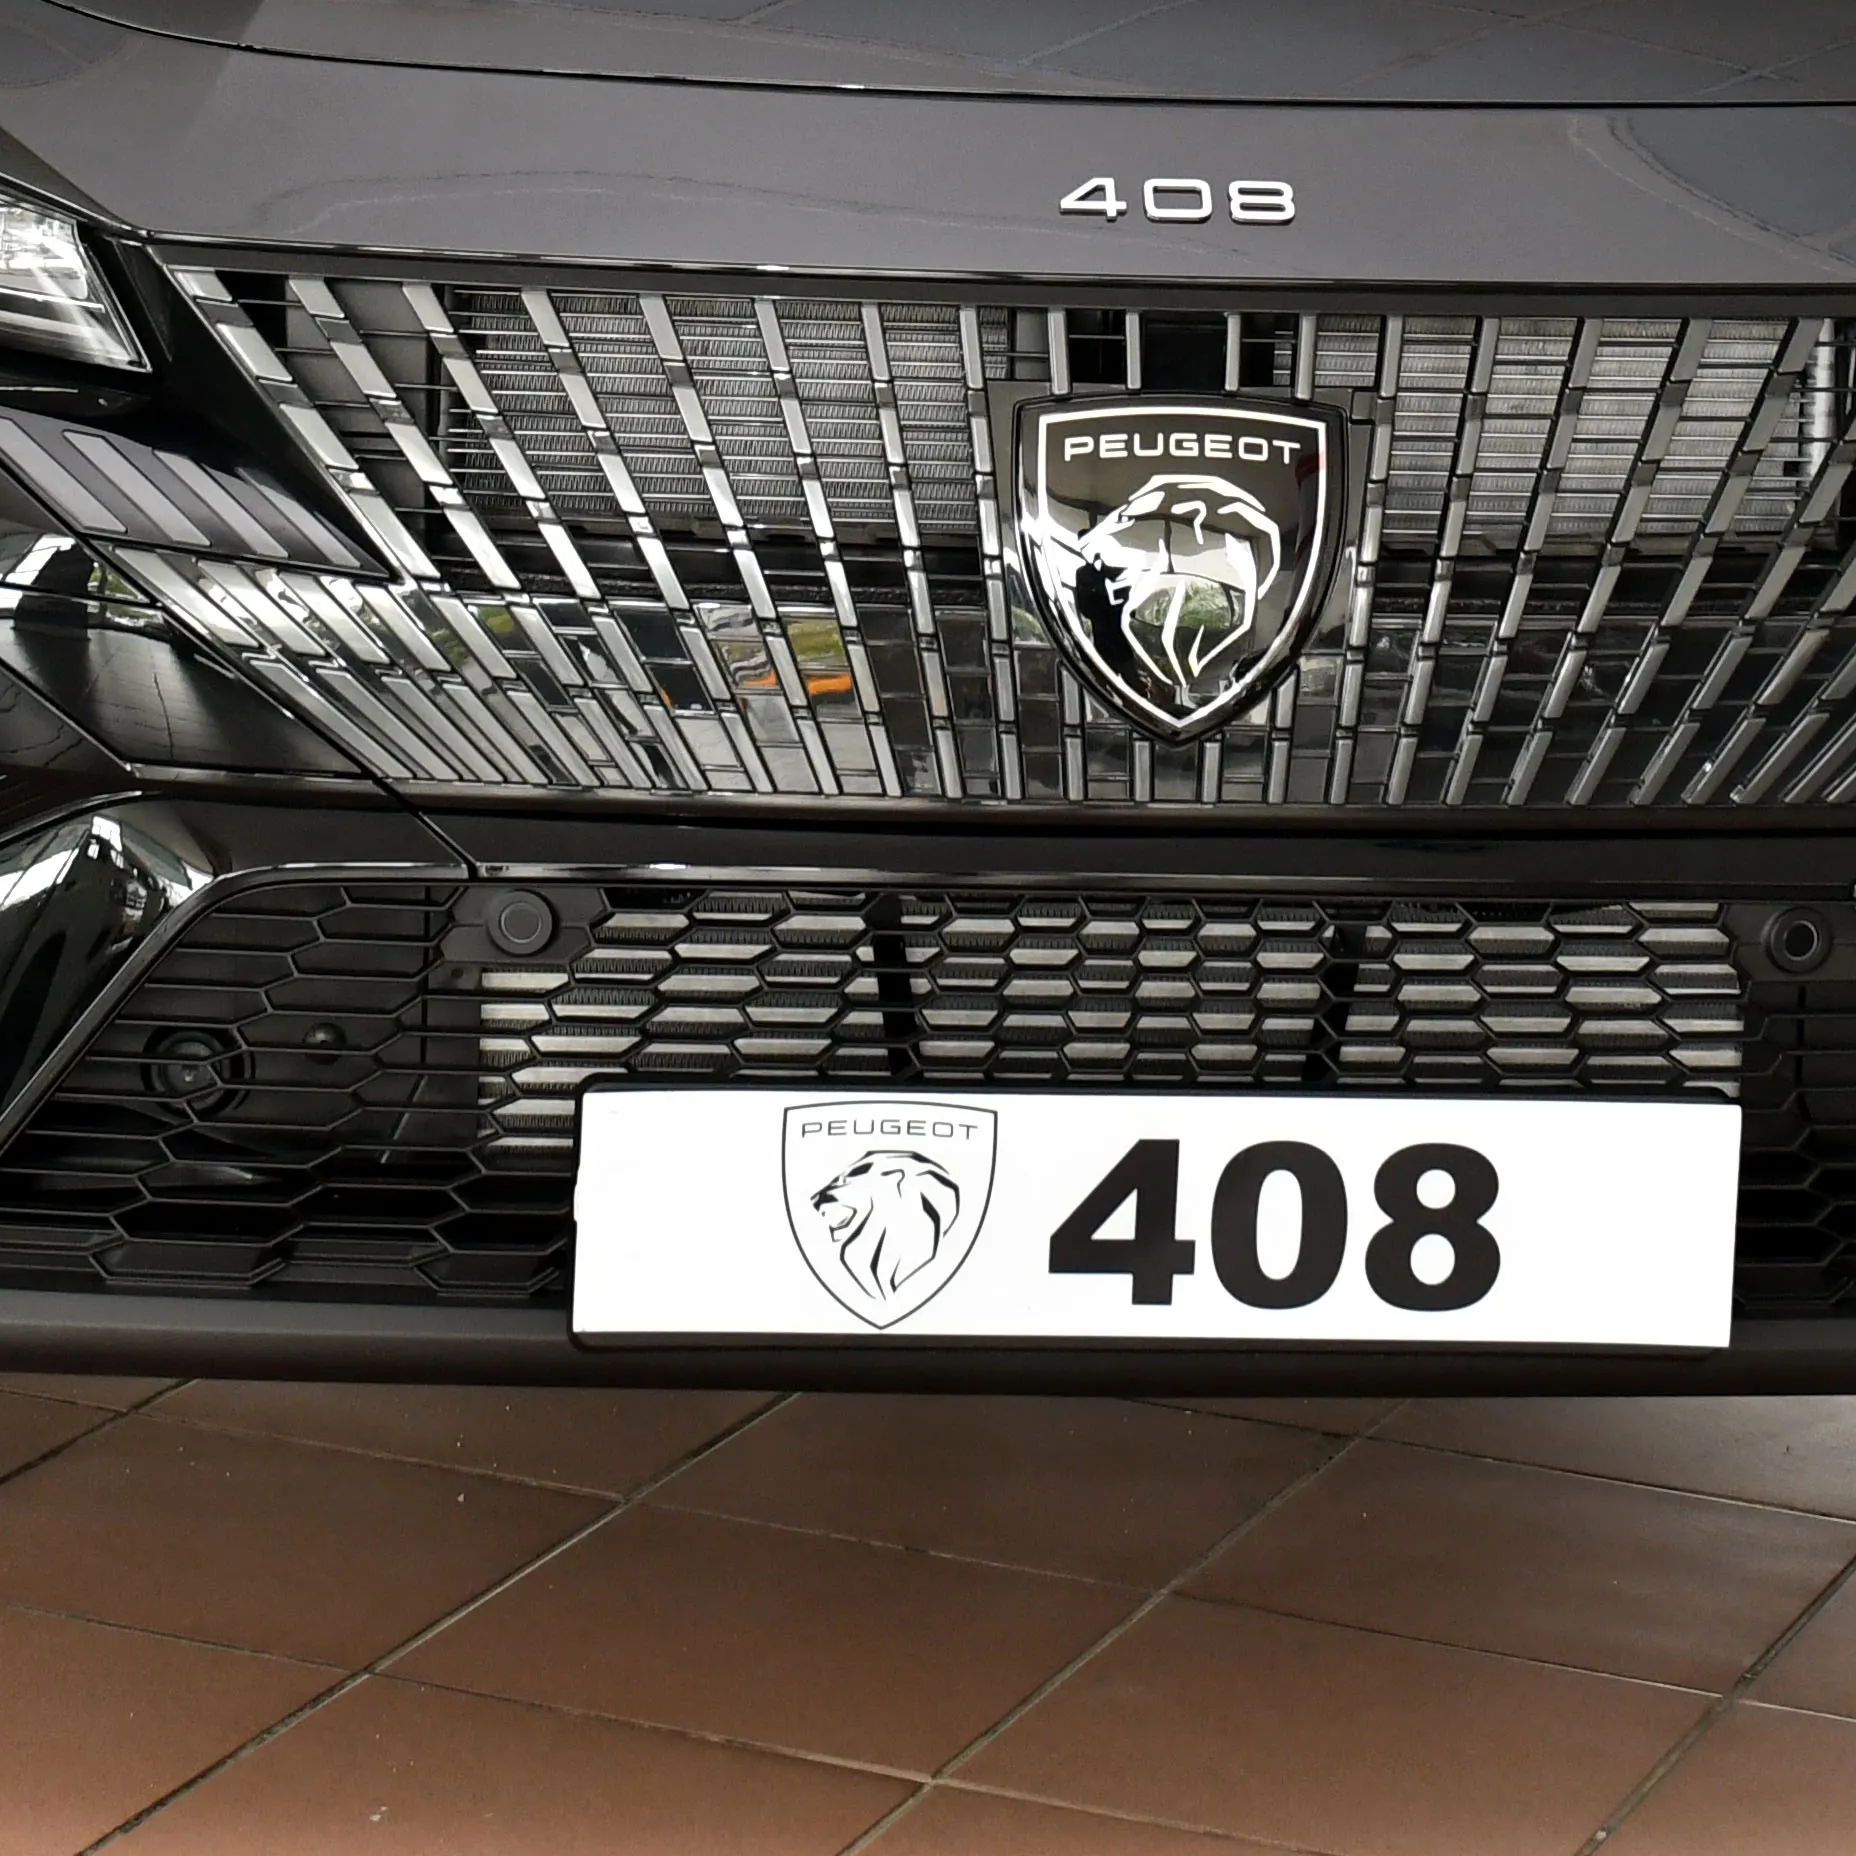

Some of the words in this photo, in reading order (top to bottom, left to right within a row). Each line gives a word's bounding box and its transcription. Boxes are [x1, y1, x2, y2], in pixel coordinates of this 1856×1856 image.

[1059, 176, 1296, 223] 408
[1064, 431, 1301, 464] PEUGEOT
[802, 1119, 979, 1140] PEUGEOT
[1047, 1138, 1502, 1312] 408
